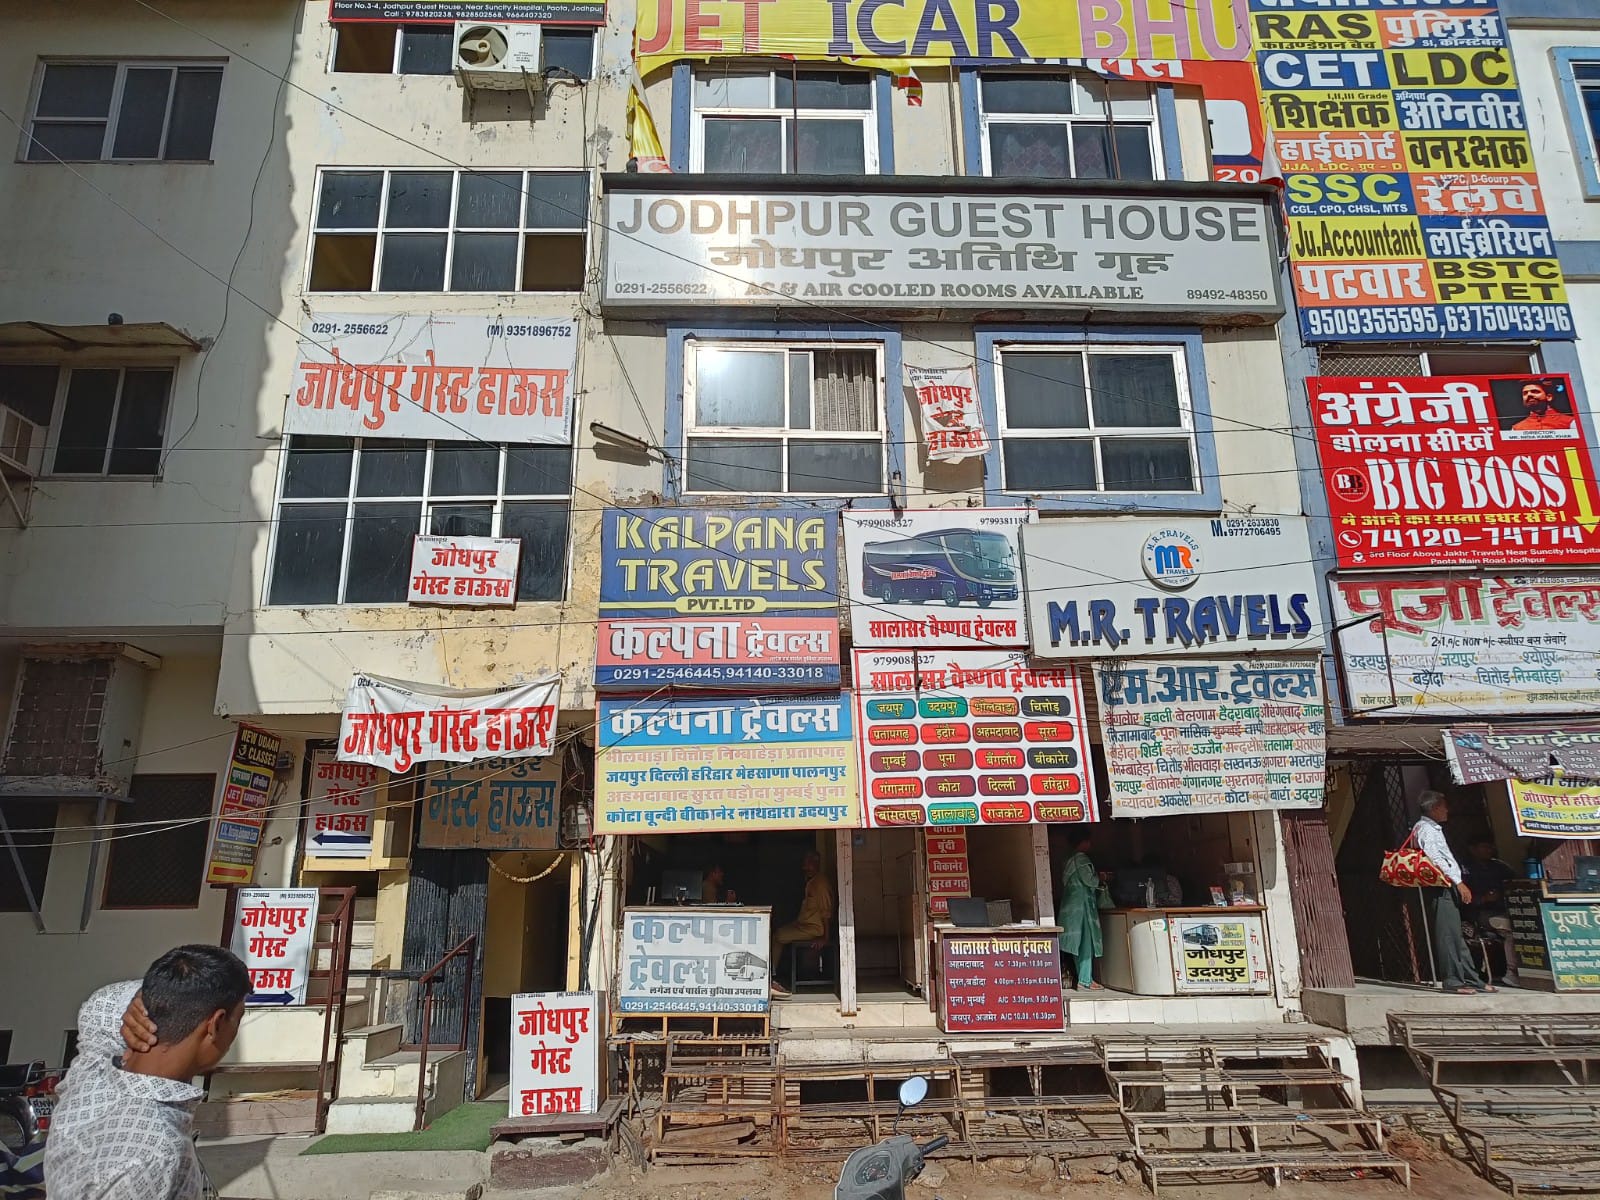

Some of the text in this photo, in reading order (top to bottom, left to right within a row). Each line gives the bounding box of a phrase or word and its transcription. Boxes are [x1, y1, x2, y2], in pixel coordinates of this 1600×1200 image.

[485, 4, 511, 12] Suncity
[637, 0, 1253, 61] JET ICAR BHU
[1255, 14, 1372, 40] RAS
[1383, 10, 1500, 47] पुलिस
[1263, 52, 1380, 88] CET
[1391, 51, 1509, 87] LDC
[1270, 93, 1391, 129] शिक्षक
[1401, 93, 1525, 129] अग्निवीर
[1276, 132, 1397, 165] हाईकोर्ट
[1405, 135, 1530, 169] वनरक्षक
[1318, 163, 1354, 172] LDC,
[1287, 174, 1401, 204] SSC
[1416, 175, 1537, 212] रेलवे
[615, 197, 1261, 243] JODHPUR GUEST HOUSE
[1290, 204, 1408, 215] CGL, CPO, CHSL, MTS
[1295, 221, 1422, 258] Ju.Accountant
[1425, 218, 1553, 259] लाईब्रेरियन
[706, 239, 1175, 282] जोधपुर अतिथि गृह
[1434, 261, 1560, 279] BSTC
[614, 282, 1269, 302] 0291-2556622 AIR COOLED ROOMS AVAILABLE 89492-48350
[1297, 263, 1427, 301] पटवार
[1440, 283, 1560, 301] PTET
[506, 324, 572, 337] 9351896752
[1309, 306, 1571, 338] 9509355595,6375043346
[296, 347, 407, 431] जोधपुर
[411, 349, 474, 414] गेस्ट
[476, 366, 569, 417] हाऊस
[916, 380, 973, 408] जोधपुर
[1317, 381, 1490, 427] अंग्रेजी
[1329, 429, 1422, 454] बोलना
[1425, 427, 1494, 453] सीखें
[1365, 454, 1567, 511] BIG BOSS
[857, 519, 913, 528] 9799088327
[1360, 510, 1542, 526] आने का रास्ता से
[616, 515, 825, 554] KALPANA
[1229, 527, 1281, 536] 9772706495
[431, 543, 499, 574] जोधपुर
[1430, 558, 1457, 566] Paota
[1508, 557, 1546, 566] Jodhpur
[1442, 549, 1469, 557] Jakhr
[1530, 548, 1564, 556] Suncity
[413, 570, 512, 597] गेस्ट हाऊस
[616, 558, 827, 596] TRAVELS
[687, 599, 755, 611] PVT.LTD
[1338, 578, 1485, 635] पूजा
[869, 615, 1017, 641] सालासर वैष्णव ट्रेवल्स
[609, 621, 833, 660] कल्पना ट्रेवल्स
[1462, 636, 1541, 646] NON बस
[1440, 652, 1476, 667] जयपुर
[614, 667, 824, 681] 0291-2546445,94140-33018
[947, 663, 1007, 689] वैष्णव
[1009, 662, 1066, 693] ट्रेवल्स
[876, 703, 904, 717] जयपुर
[926, 702, 958, 715] उदयपुर
[1175, 707, 1217, 722] बेलगाम
[609, 699, 841, 741] कल्पना ट्रेवल्स
[343, 699, 425, 773] जोधपुर
[428, 704, 481, 753] गेस्ट
[485, 704, 555, 751] हाऊस
[976, 728, 1020, 738] अहमदाबाद
[248, 746, 276, 766] CLASSES
[1034, 752, 1070, 764] बीकानेर
[1192, 741, 1223, 755] उज्जैन
[317, 762, 377, 787] जोधपुर
[605, 765, 847, 787] जयपुर दिल्ली हरिद्वार पालनपुर
[987, 778, 1017, 792] दिल्ली
[227, 788, 241, 800] JET
[606, 790, 688, 804] अहमदाबाद
[937, 780, 961, 792] कोटा
[1114, 780, 1142, 794] जयपुर
[1224, 789, 1249, 804] कोटा
[315, 813, 369, 832] हाऊस
[606, 808, 641, 823] कोटा
[680, 805, 735, 822] बीकानेर
[798, 804, 848, 823] उदयपुर
[985, 804, 1025, 819] राजकोट
[240, 900, 309, 935] जोधपुर
[1548, 911, 1592, 933] पूजा
[631, 915, 761, 944] कल्पना
[250, 931, 289, 958] गेस्ट
[950, 940, 990, 955] सालासर
[1022, 936, 1053, 958] ट्रेवल्स
[1184, 945, 1246, 964] जोधपुर
[628, 945, 720, 991] ट्रेवल्स
[949, 961, 984, 969] अहमदाबाद
[1187, 967, 1247, 982] उदयपुर
[650, 985, 671, 994] लगेज
[685, 985, 708, 995] पार्सल
[625, 1001, 764, 1012] 0291-2546445,94140-33018
[976, 1011, 997, 1021] अजमेर
[518, 1001, 590, 1043] जोधपुर
[531, 1040, 573, 1075] गेस्ट
[520, 1087, 583, 1116] हाऊस
